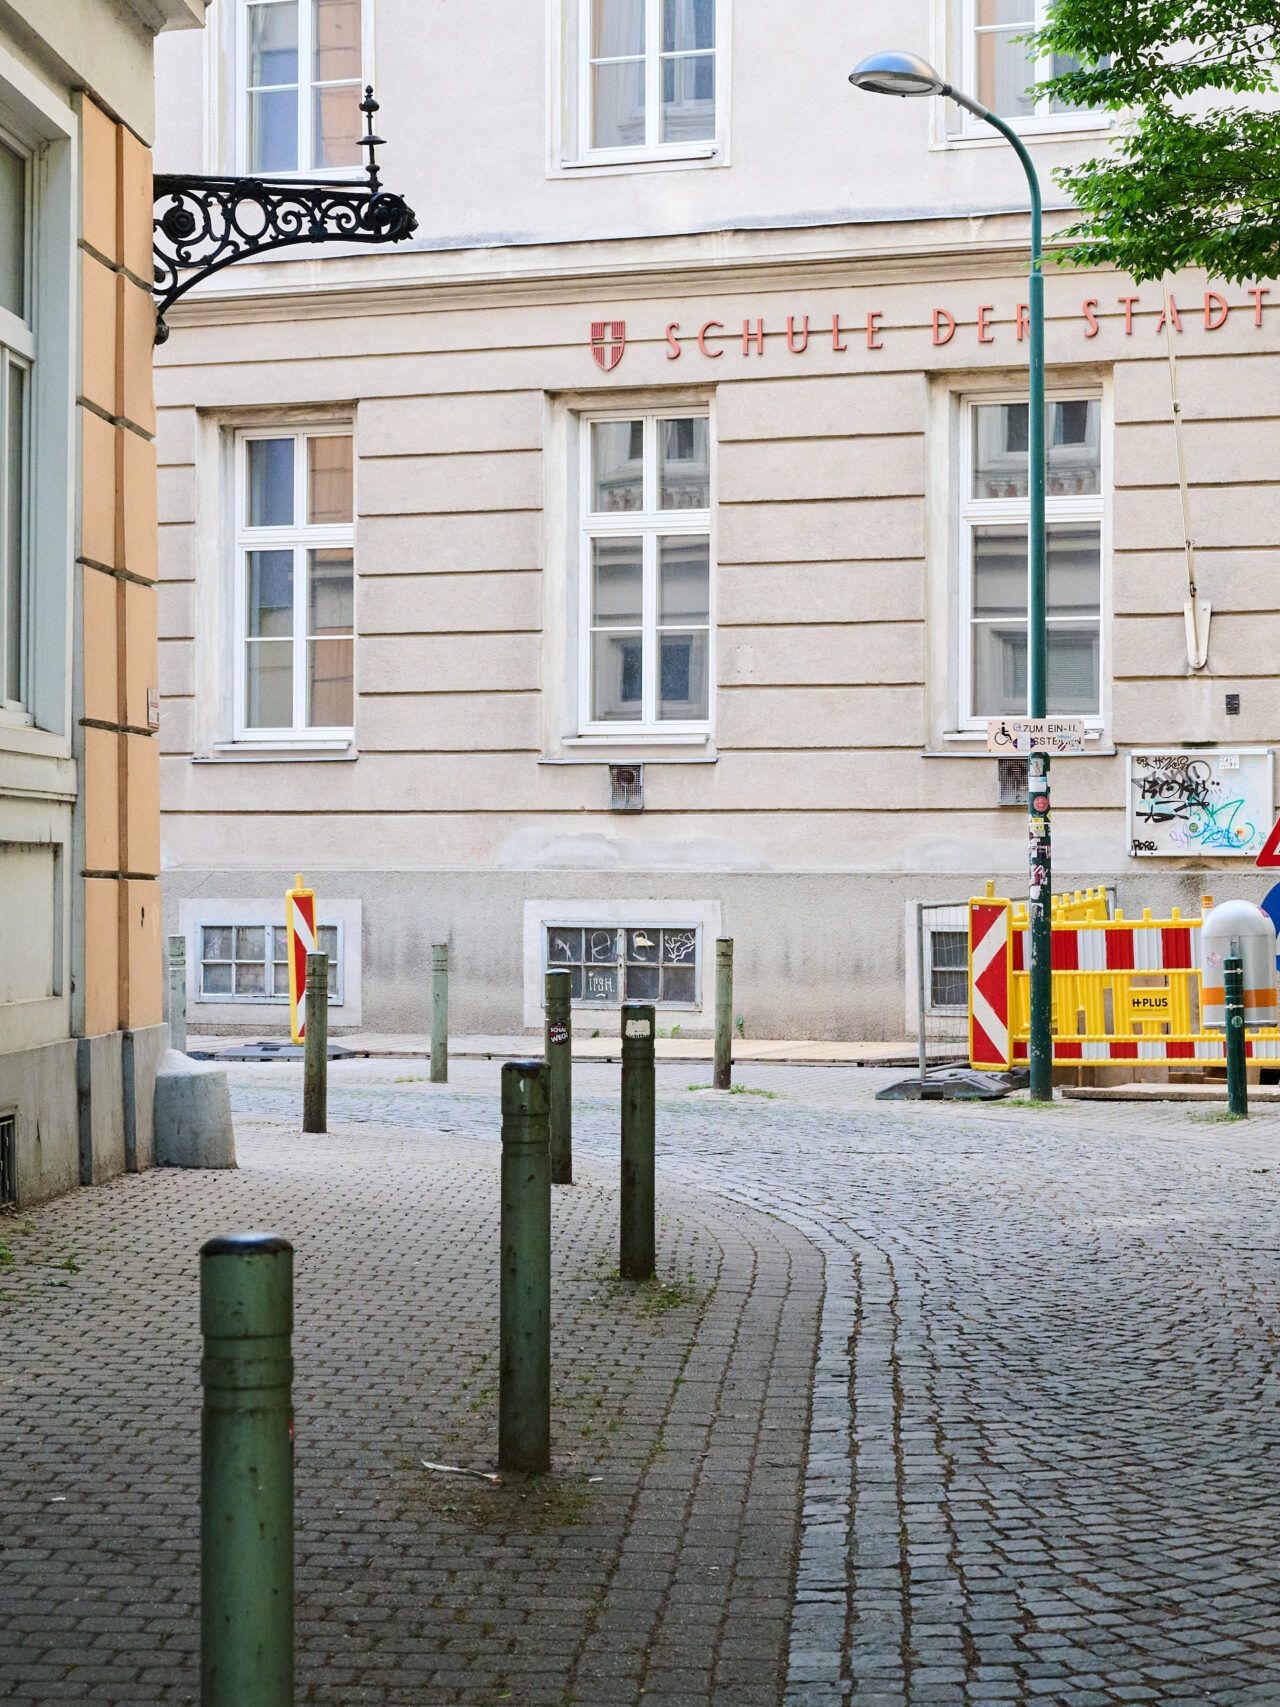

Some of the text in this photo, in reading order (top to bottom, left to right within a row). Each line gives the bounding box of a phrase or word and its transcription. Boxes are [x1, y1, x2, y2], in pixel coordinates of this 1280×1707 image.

[665, 311, 884, 360] SCHULE
[932, 303, 1030, 346] DER
[1082, 287, 1270, 338] STADT
[1023, 724, 1043, 733] ZUM
